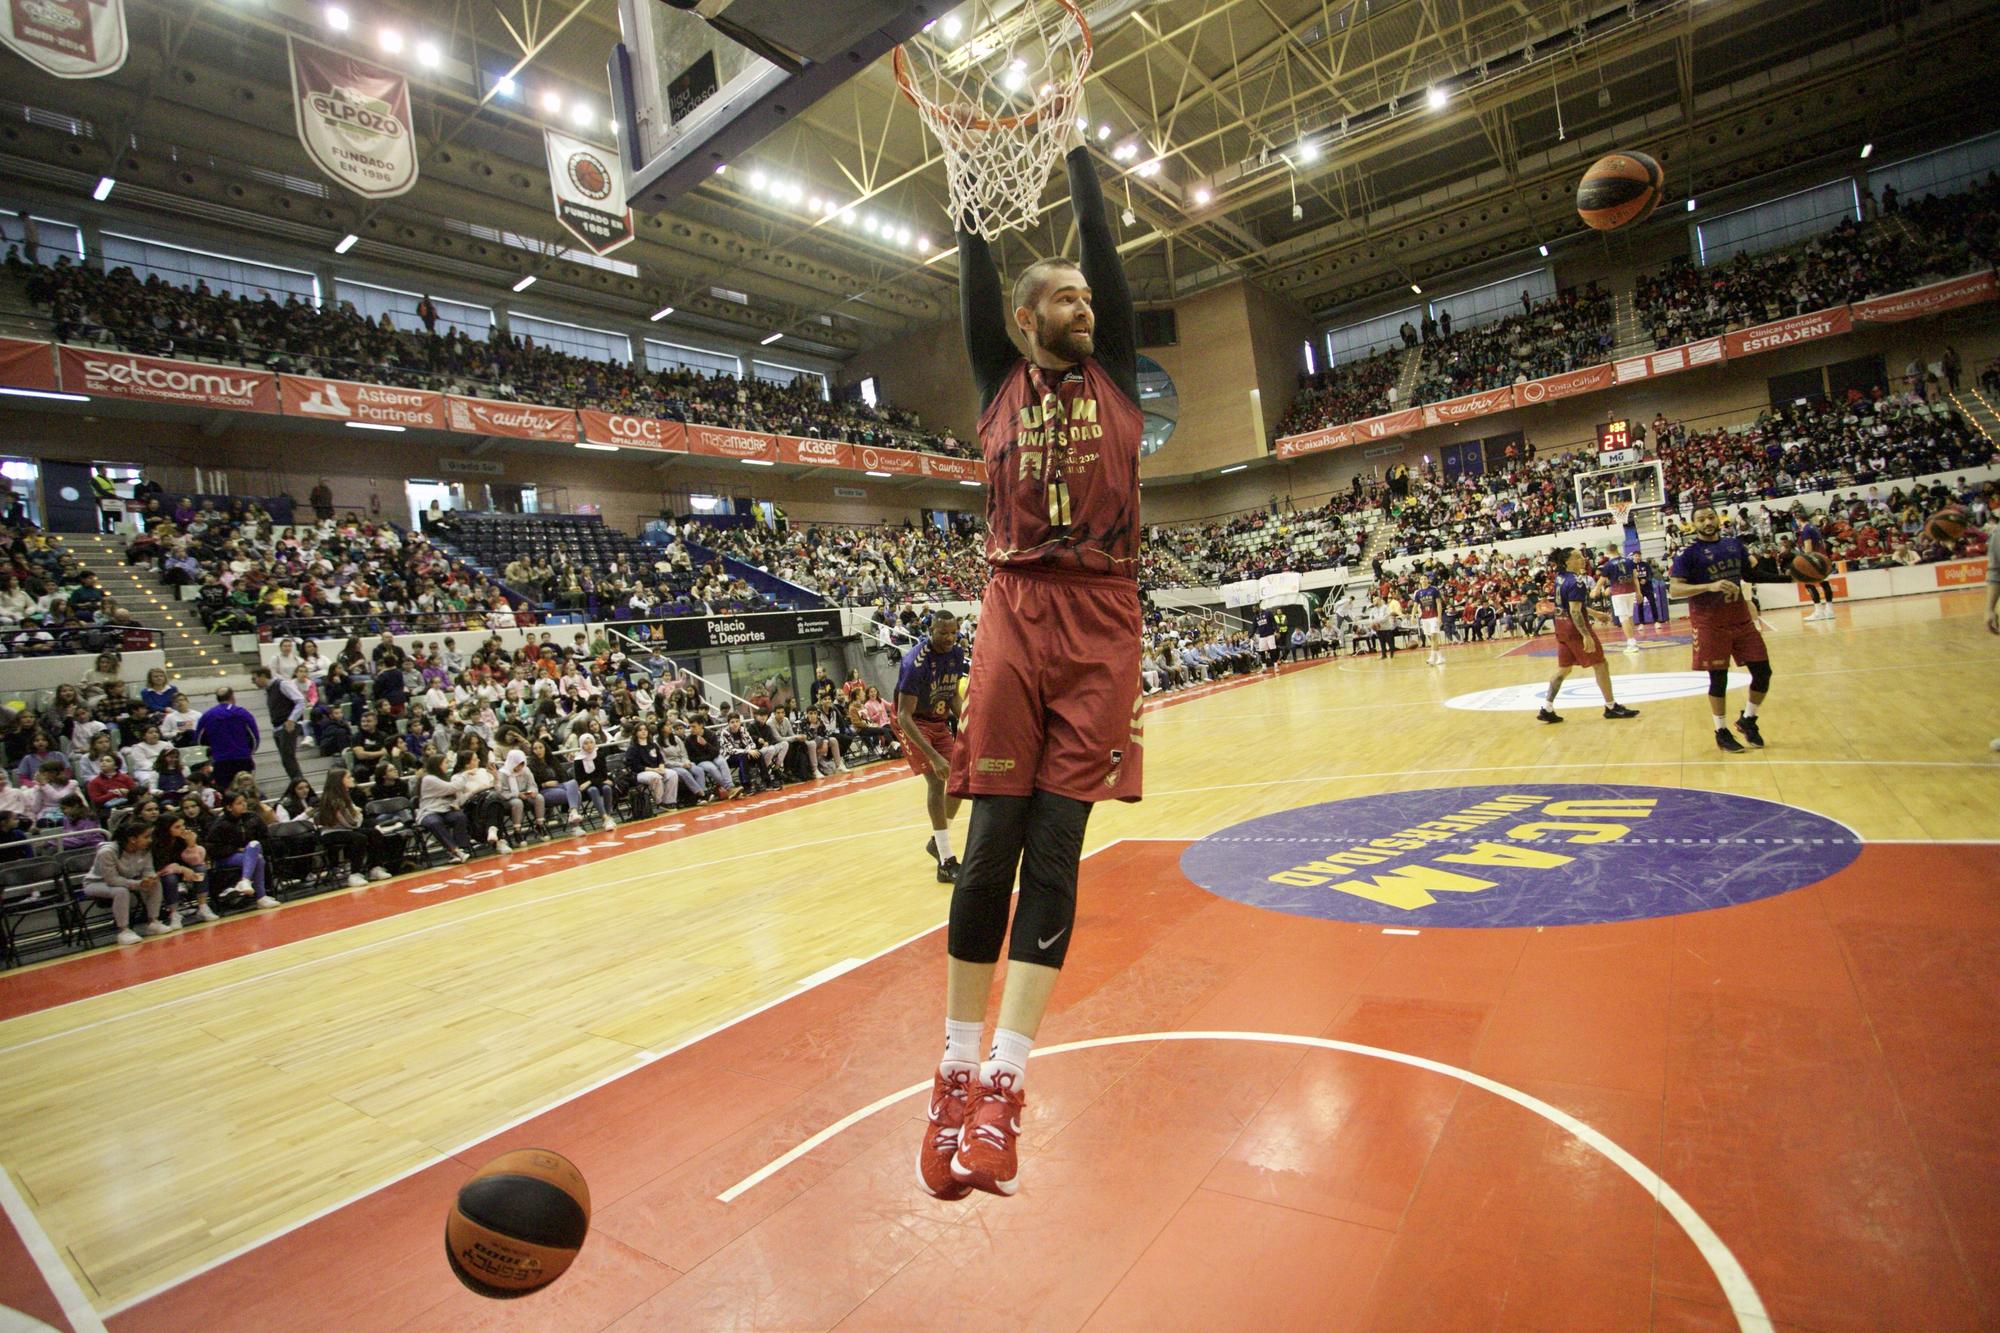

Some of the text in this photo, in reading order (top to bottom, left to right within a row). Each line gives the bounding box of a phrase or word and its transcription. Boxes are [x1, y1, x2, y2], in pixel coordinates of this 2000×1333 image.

[332, 147, 395, 171] FUNDADO
[340, 161, 357, 174] EN
[84, 360, 259, 397] setcomur
[357, 387, 423, 407] Asterra
[358, 404, 434, 424] Partners
[805, 441, 837, 455] caser
[1295, 432, 1348, 451] CaixaBank
[1604, 433, 1627, 450] 24
[708, 620, 745, 633] Palacio
[719, 631, 765, 645] Deportes
[1266, 794, 1553, 887] UNIVERSIDAD
[1328, 797, 1659, 912] UCAM
[407, 839, 626, 894] Murcia
